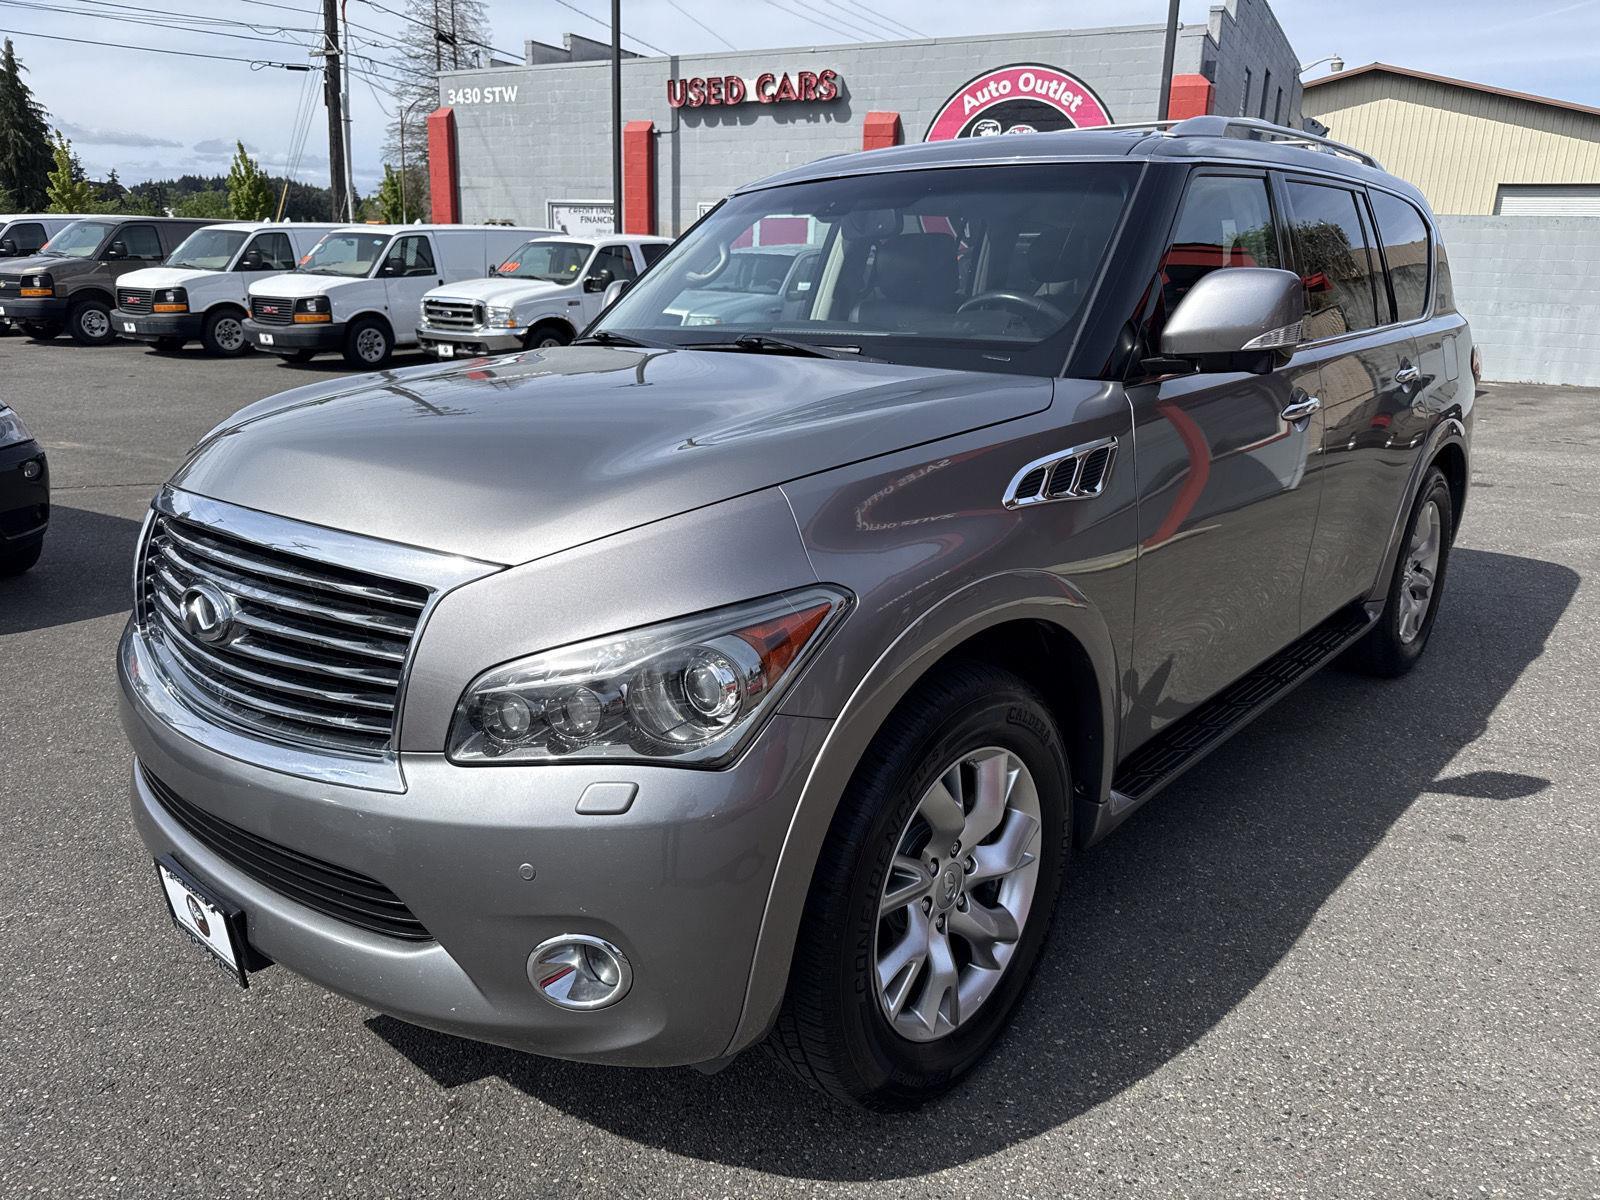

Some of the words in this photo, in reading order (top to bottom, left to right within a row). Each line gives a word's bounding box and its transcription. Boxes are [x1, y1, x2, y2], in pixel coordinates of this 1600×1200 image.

[447, 87, 481, 105] 3430
[483, 85, 518, 104] STW
[667, 75, 747, 109] USED
[755, 69, 838, 104] CARS
[962, 79, 1012, 116] Auto
[1018, 72, 1083, 113] Outlet
[580, 216, 615, 224] FINANCIN
[596, 207, 615, 215] UNIO
[1009, 707, 1051, 743] CALDERA
